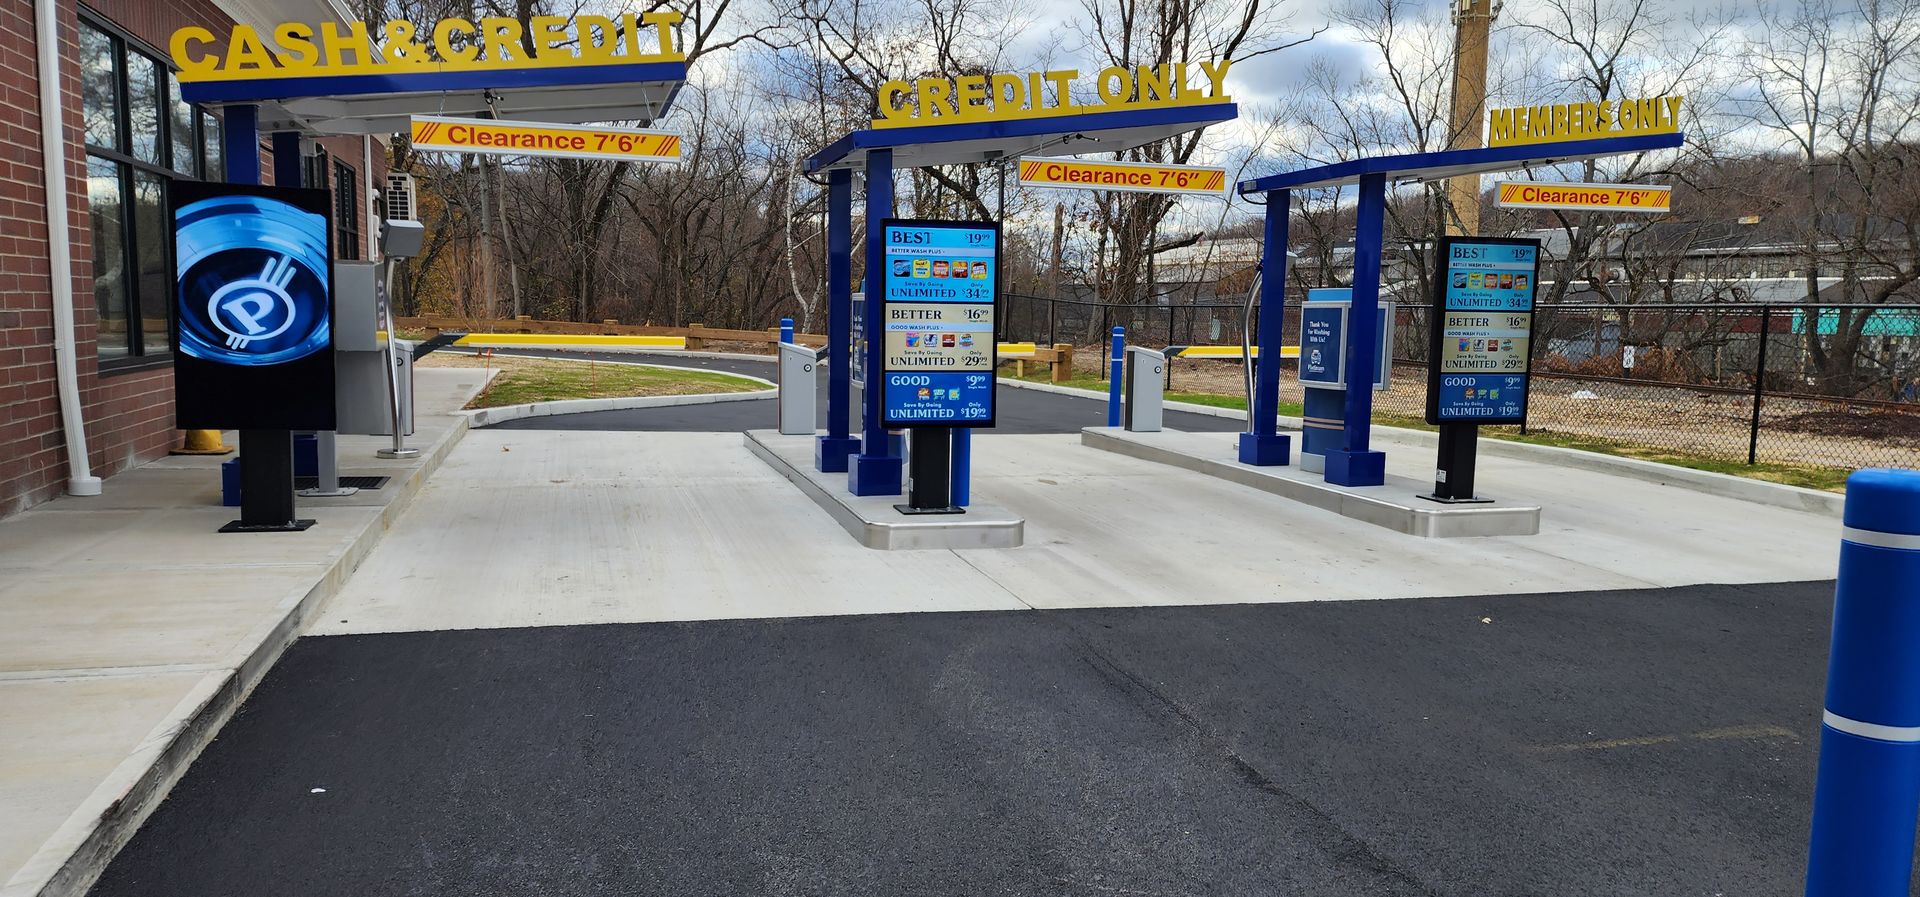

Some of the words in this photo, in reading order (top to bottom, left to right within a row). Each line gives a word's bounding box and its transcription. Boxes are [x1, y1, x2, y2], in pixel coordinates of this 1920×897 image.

[169, 11, 684, 80] CASH&CREDIT
[878, 69, 1080, 121] CREDIT
[1096, 60, 1232, 107] ONLY
[1490, 100, 1612, 144] MEMBERS
[1618, 96, 1683, 133] ONLY
[448, 125, 585, 150] Clearance
[1046, 165, 1152, 186] Clearance
[1522, 187, 1610, 205] Clearance
[892, 230, 932, 244] BEST
[1454, 247, 1488, 259] BEST
[891, 288, 956, 298] UNLIMITED
[1450, 298, 1502, 307] UNLIMITED
[891, 309, 942, 320] BETTER
[1448, 317, 1490, 326] BETTER
[890, 356, 956, 366] UNLIMITED
[1445, 360, 1498, 368] UNLIMITED
[890, 375, 930, 386] GOOD
[1444, 376, 1476, 387] GOOD
[890, 408, 955, 418] UNLIMITED
[1442, 407, 1494, 416] UNLIMITED
